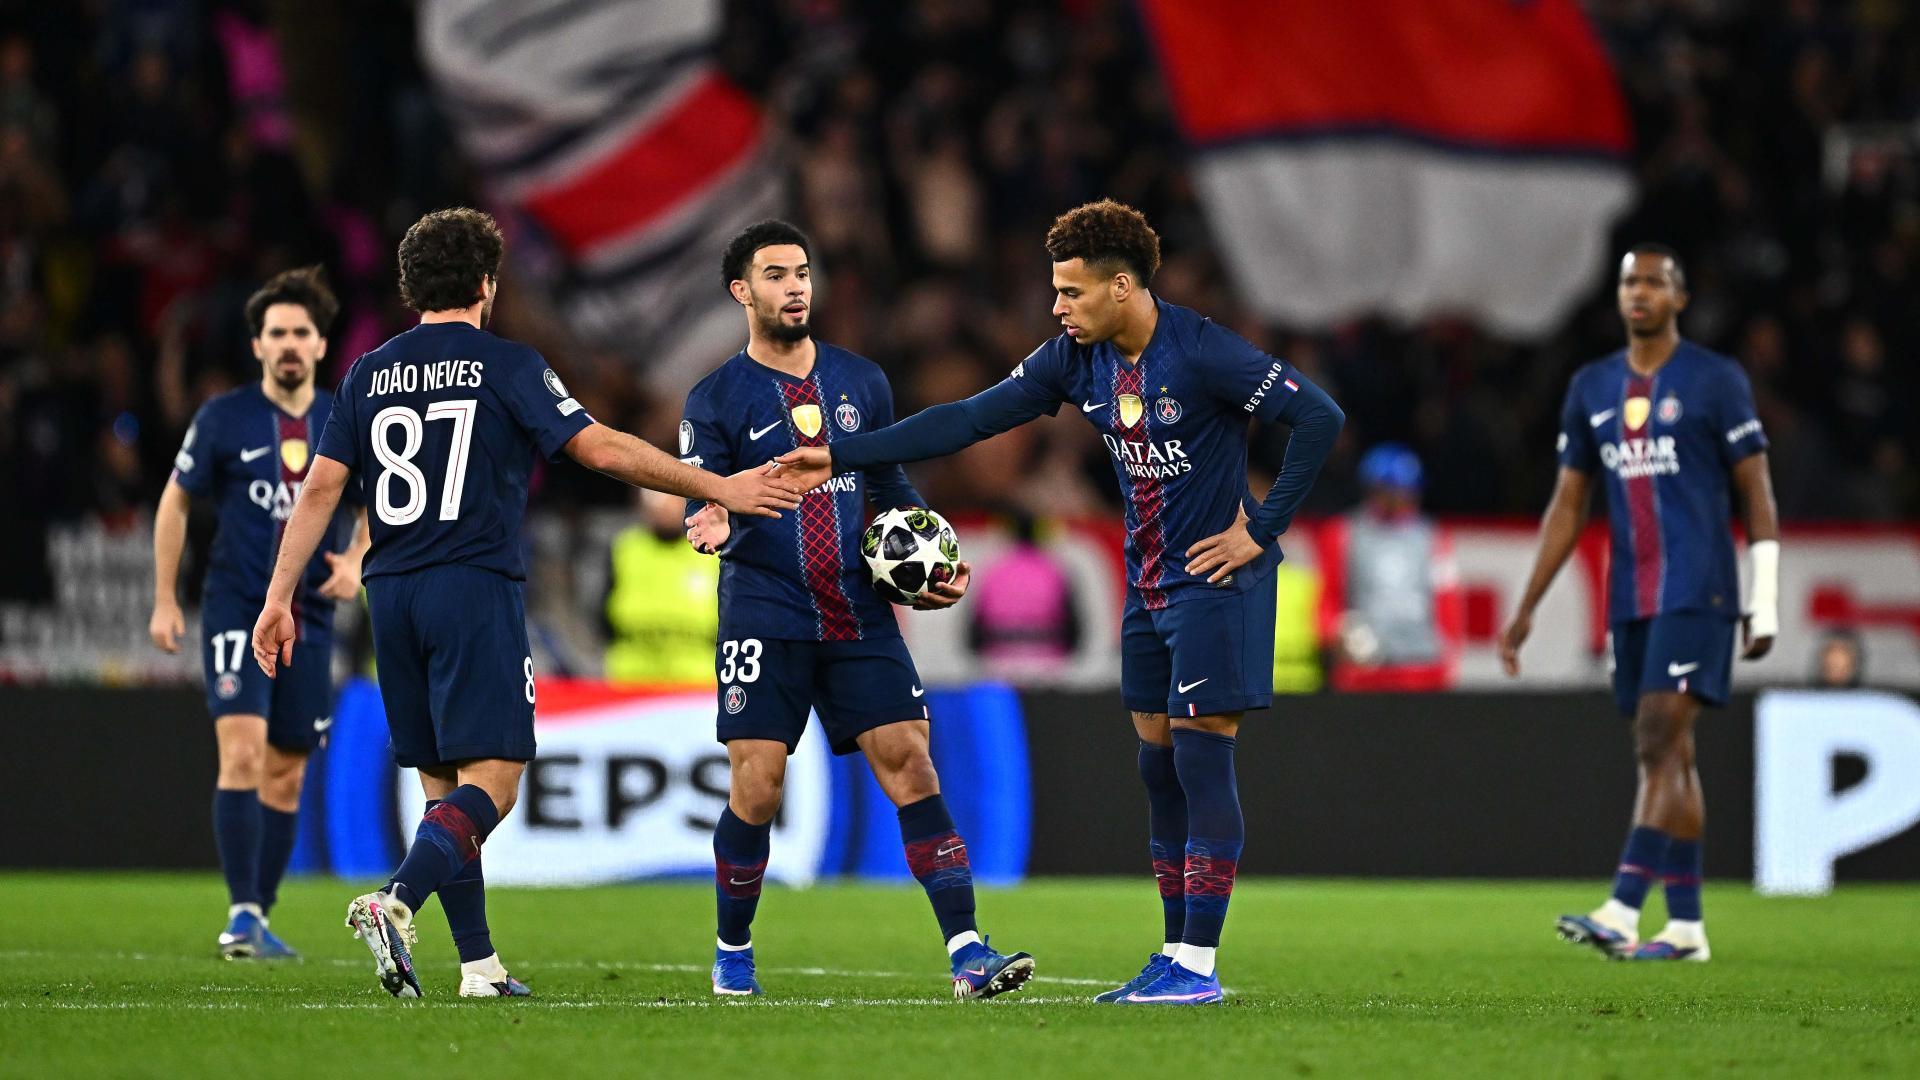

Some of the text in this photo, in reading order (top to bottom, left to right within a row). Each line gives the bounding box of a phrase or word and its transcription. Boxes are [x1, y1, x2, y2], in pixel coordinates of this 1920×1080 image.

[367, 360, 483, 397] JOÃO NEVES
[1243, 362, 1282, 412] BEYOND
[370, 399, 478, 526] 87
[1102, 433, 1188, 464] QATAR
[1600, 435, 1677, 470] QATAR
[804, 476, 856, 495] WAYS
[1125, 460, 1192, 479] AIRWAYS
[248, 480, 304, 511] QAT
[211, 630, 248, 674] 17
[720, 638, 763, 684] 33
[525, 754, 785, 830] EPS
